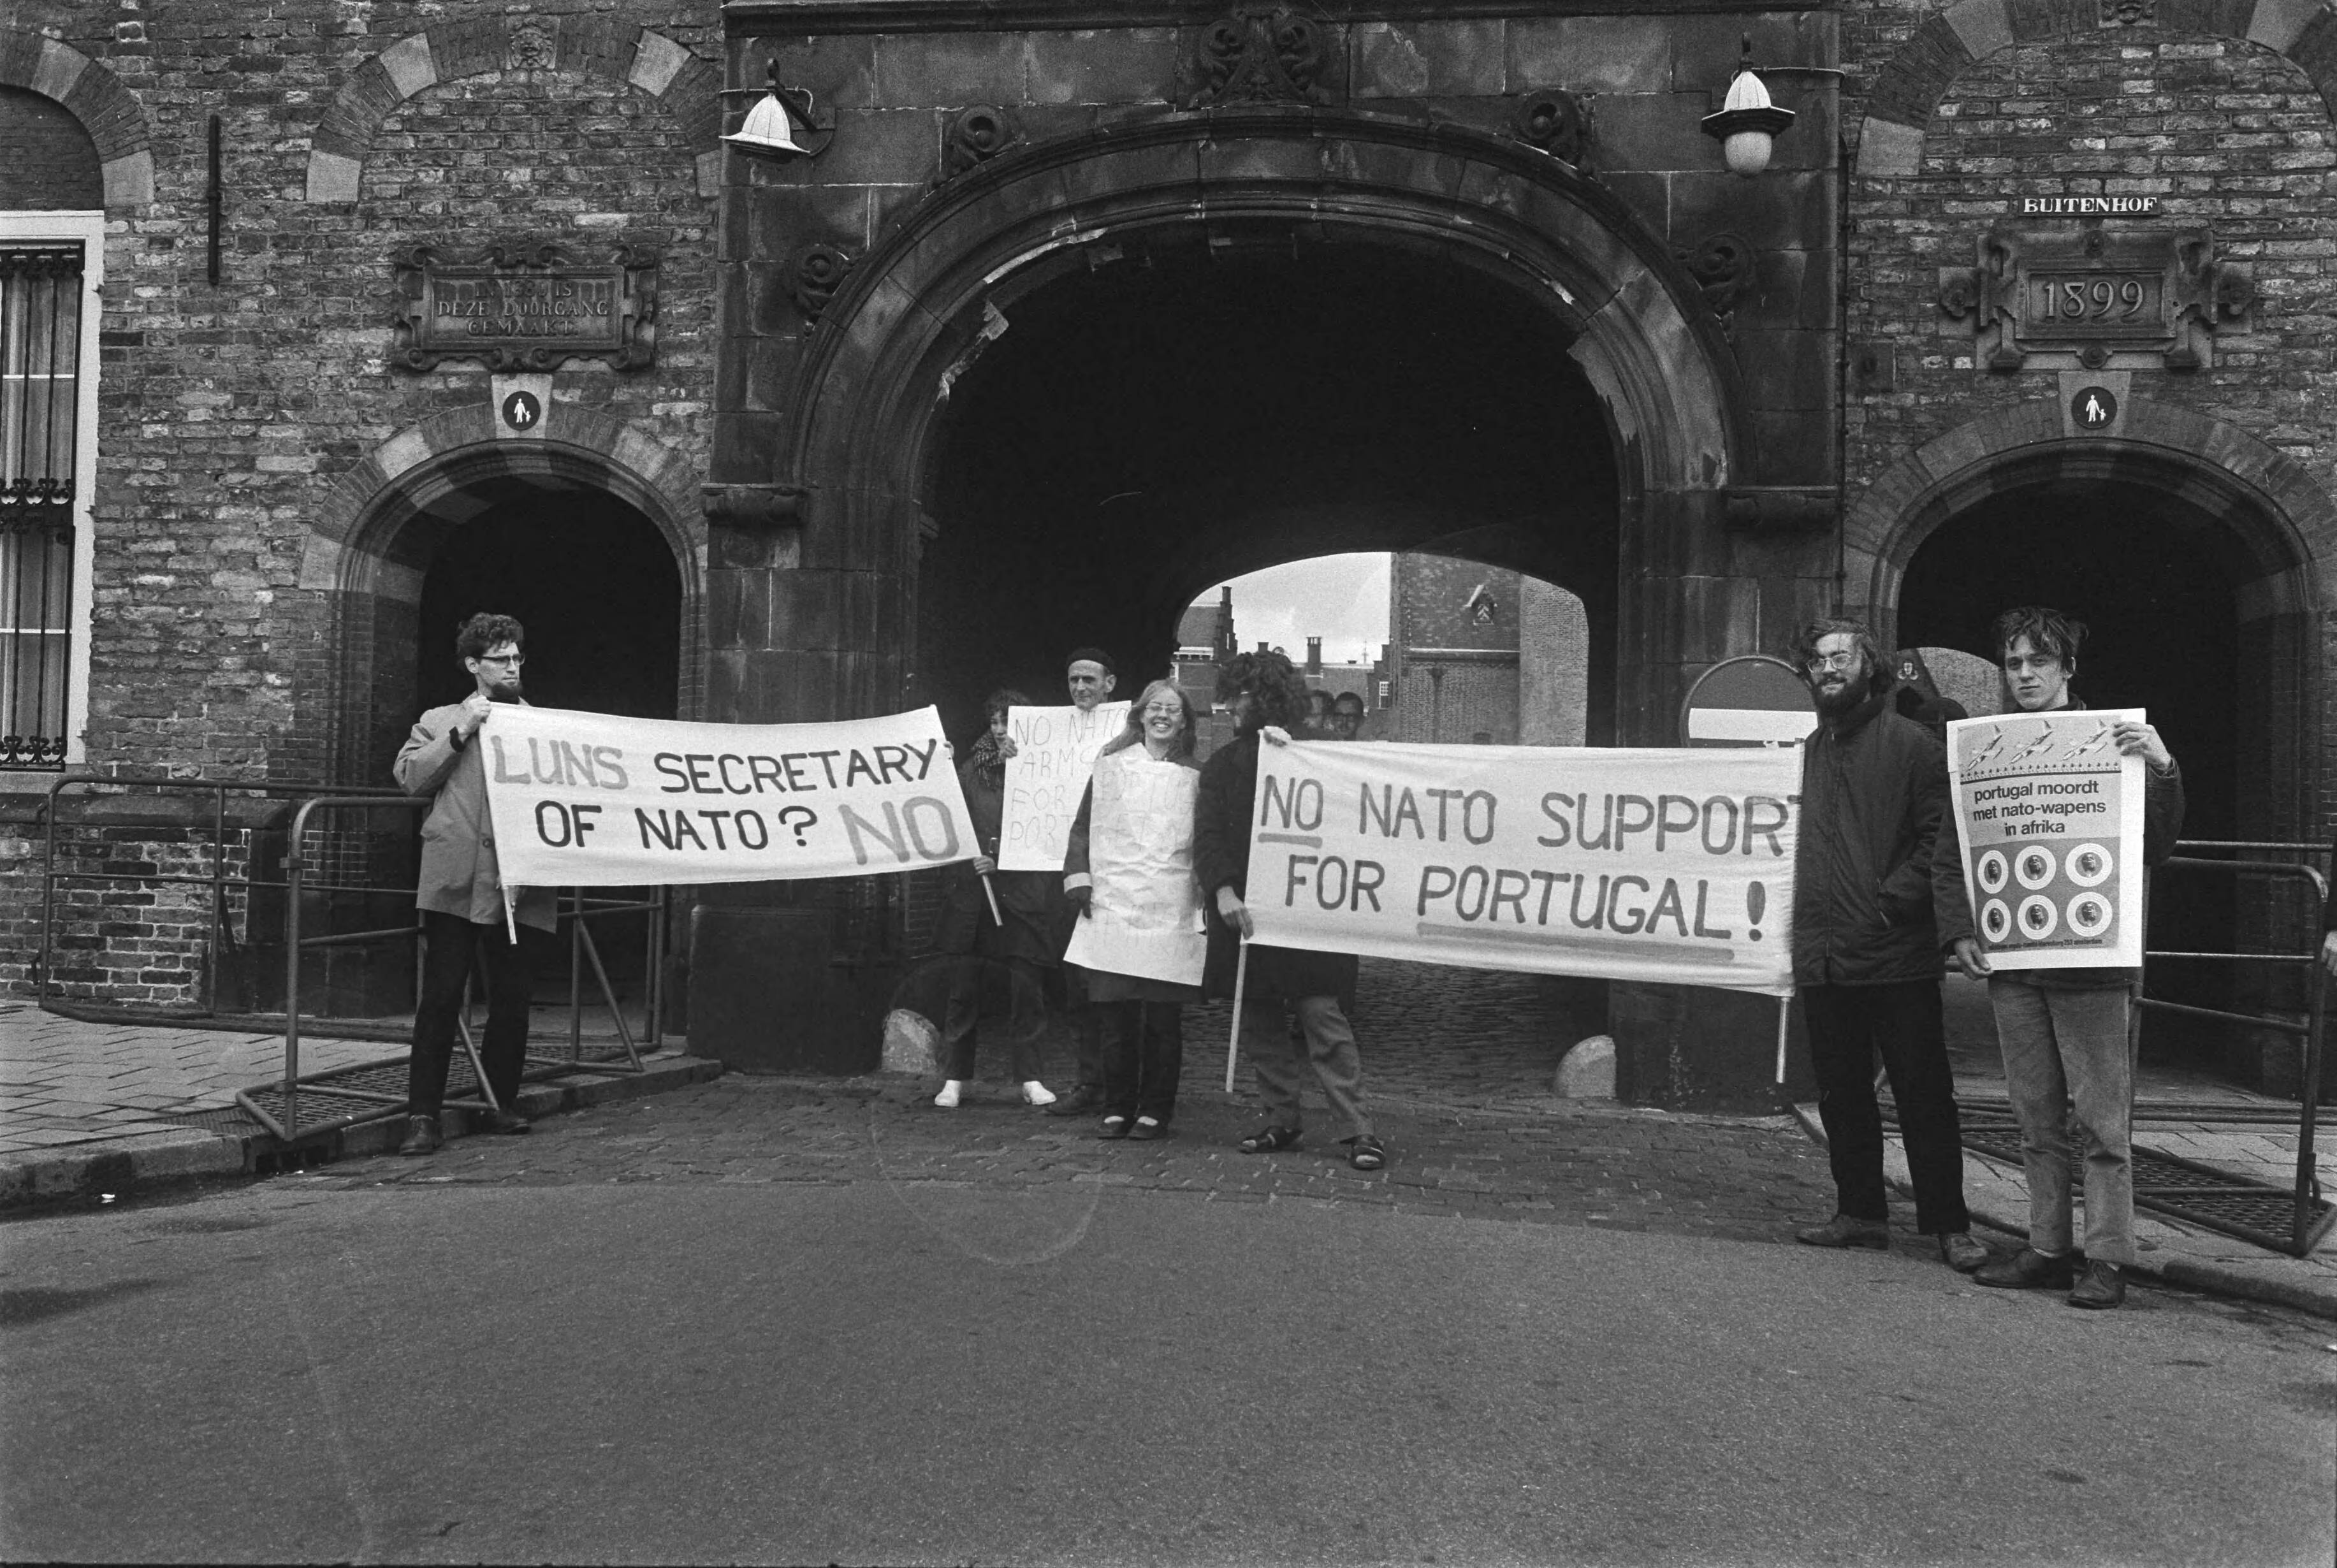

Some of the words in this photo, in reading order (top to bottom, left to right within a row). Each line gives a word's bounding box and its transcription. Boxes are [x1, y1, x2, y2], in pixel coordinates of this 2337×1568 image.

[2023, 197, 2158, 214] BUITENHOF
[555, 281, 572, 297] IS
[2044, 280, 2144, 317] 1899
[437, 301, 488, 317] DEZE
[504, 301, 608, 317] DOORGANG
[1015, 716, 1051, 746] NO
[490, 736, 630, 790] LUNS
[653, 738, 938, 795] SECRETARY
[1011, 784, 1065, 811] FOR
[1974, 783, 2034, 804] portugal
[2038, 780, 2100, 796] moordt
[1260, 774, 1324, 831] NO
[1359, 782, 1497, 845] NATO
[1537, 792, 1802, 857] SUPPOR
[1973, 806, 1998, 821] met
[2001, 800, 2107, 818] nato-wapens
[535, 800, 602, 848] OF
[838, 796, 960, 866] NO
[2005, 822, 2017, 836] in
[2021, 820, 2065, 834] afrika
[1285, 853, 1386, 912] FOR
